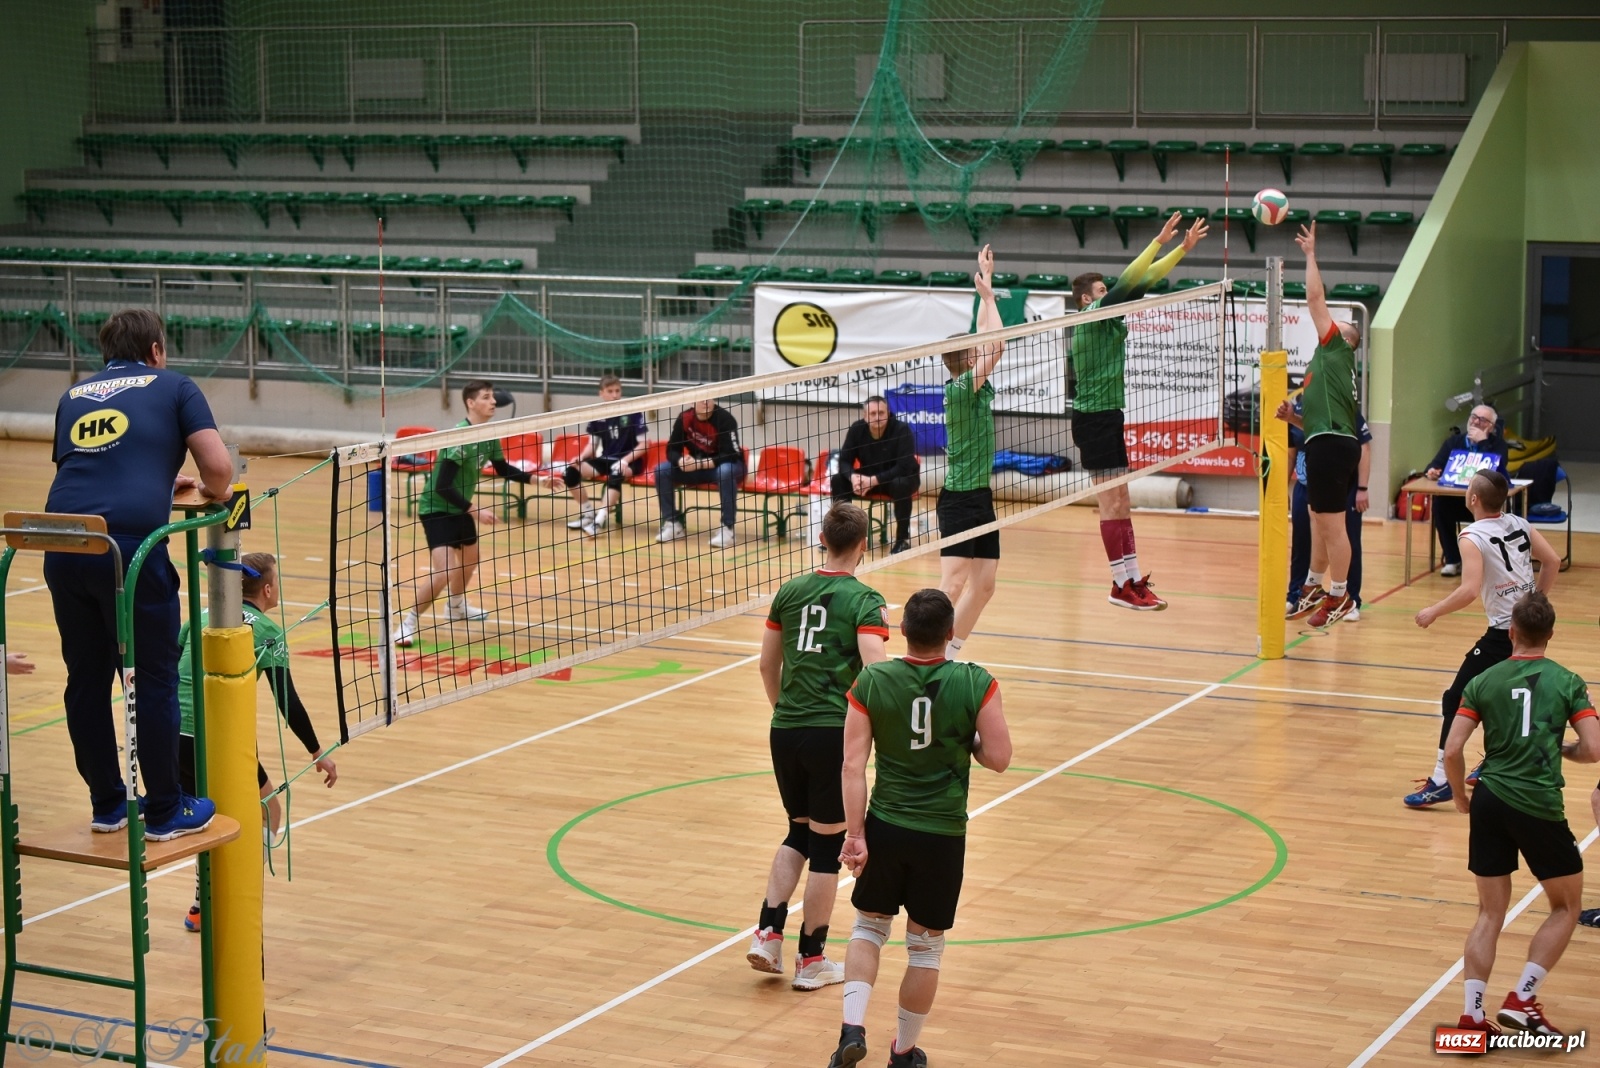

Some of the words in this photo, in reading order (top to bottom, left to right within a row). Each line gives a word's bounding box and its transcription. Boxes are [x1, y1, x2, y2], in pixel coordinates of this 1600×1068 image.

[74, 377, 147, 396] TWINPIGS
[78, 415, 119, 441] HK
[1141, 431, 1172, 449] 496
[1185, 456, 1230, 467] Opawska
[1231, 457, 1245, 468] 45
[796, 604, 827, 653] 12
[1511, 687, 1532, 737] 7
[910, 696, 932, 750] 9
[1522, 975, 1538, 992] FILA
[1475, 991, 1483, 1010] FILA
